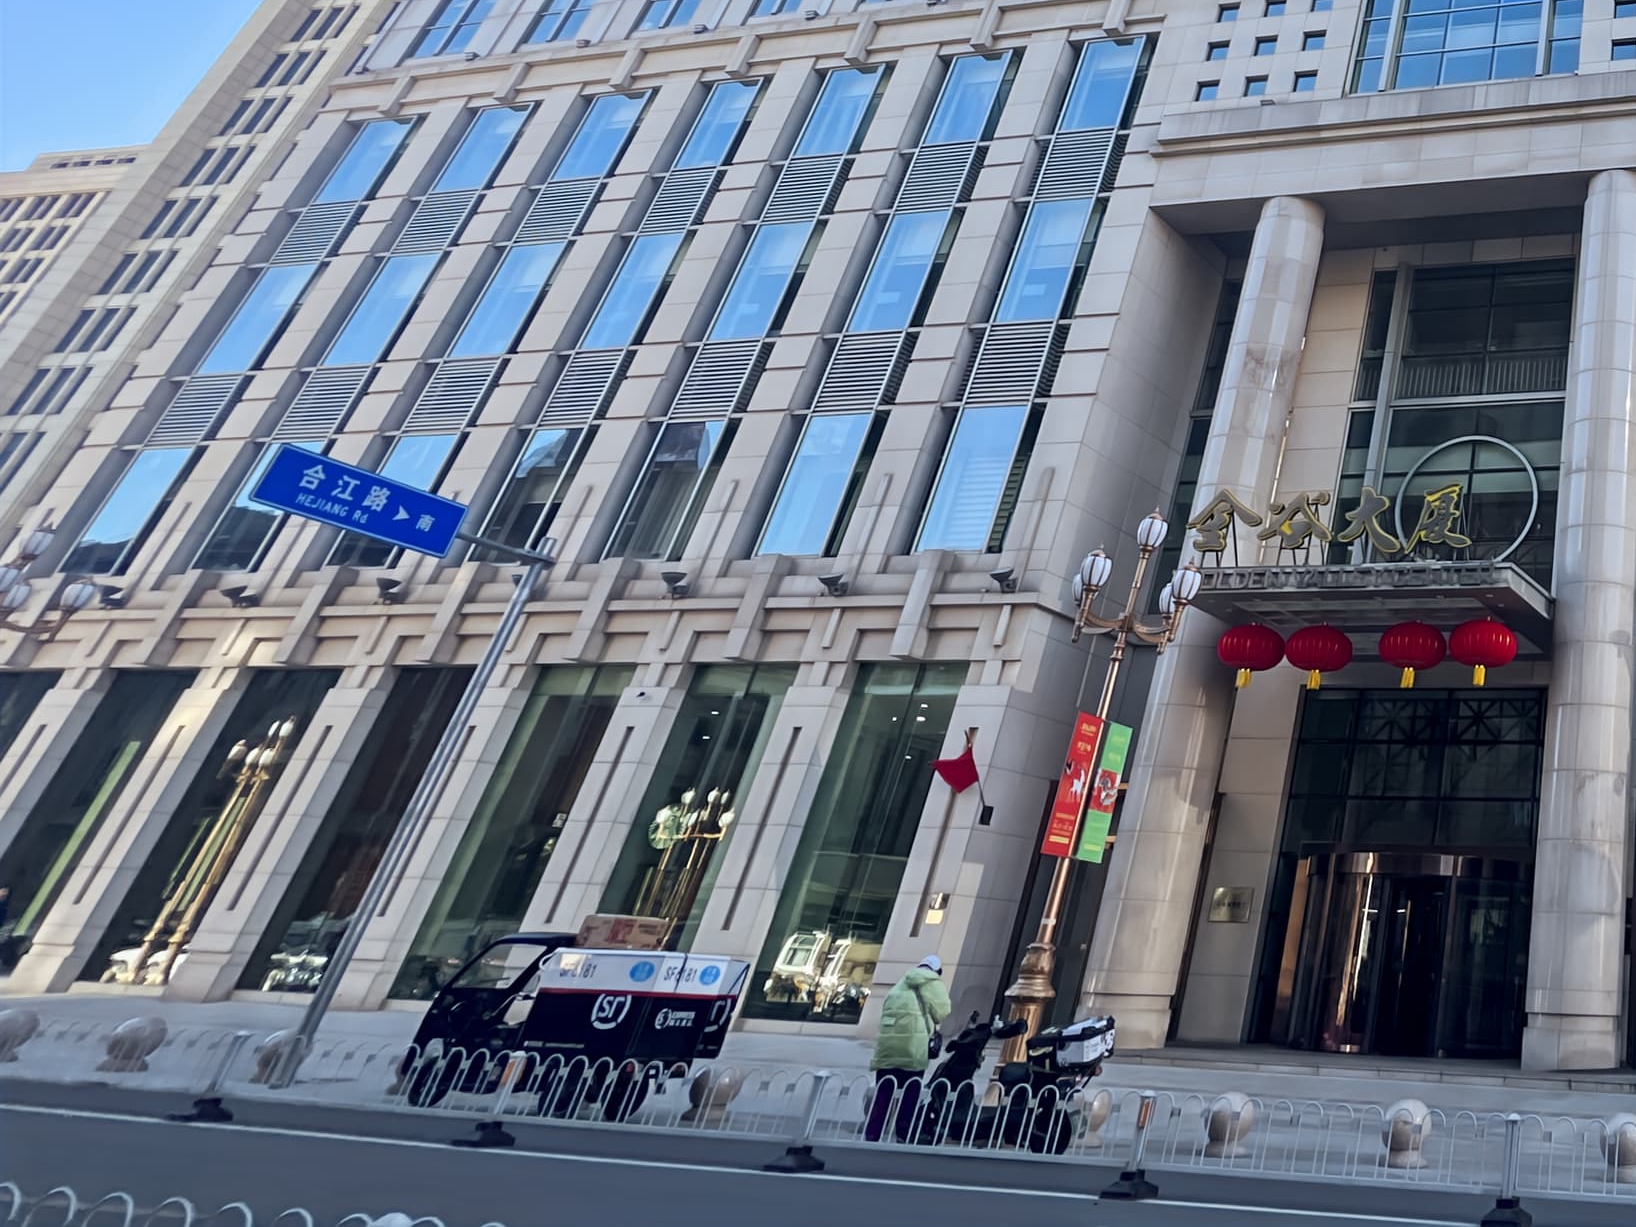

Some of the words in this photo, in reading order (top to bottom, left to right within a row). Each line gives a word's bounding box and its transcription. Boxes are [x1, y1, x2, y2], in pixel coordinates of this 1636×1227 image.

[296, 493, 349, 517] HEJIANG
[352, 510, 369, 523] Rd
[299, 464, 391, 512] 合江路
[416, 514, 435, 532] 南
[1186, 483, 1472, 555] 金谷大厦
